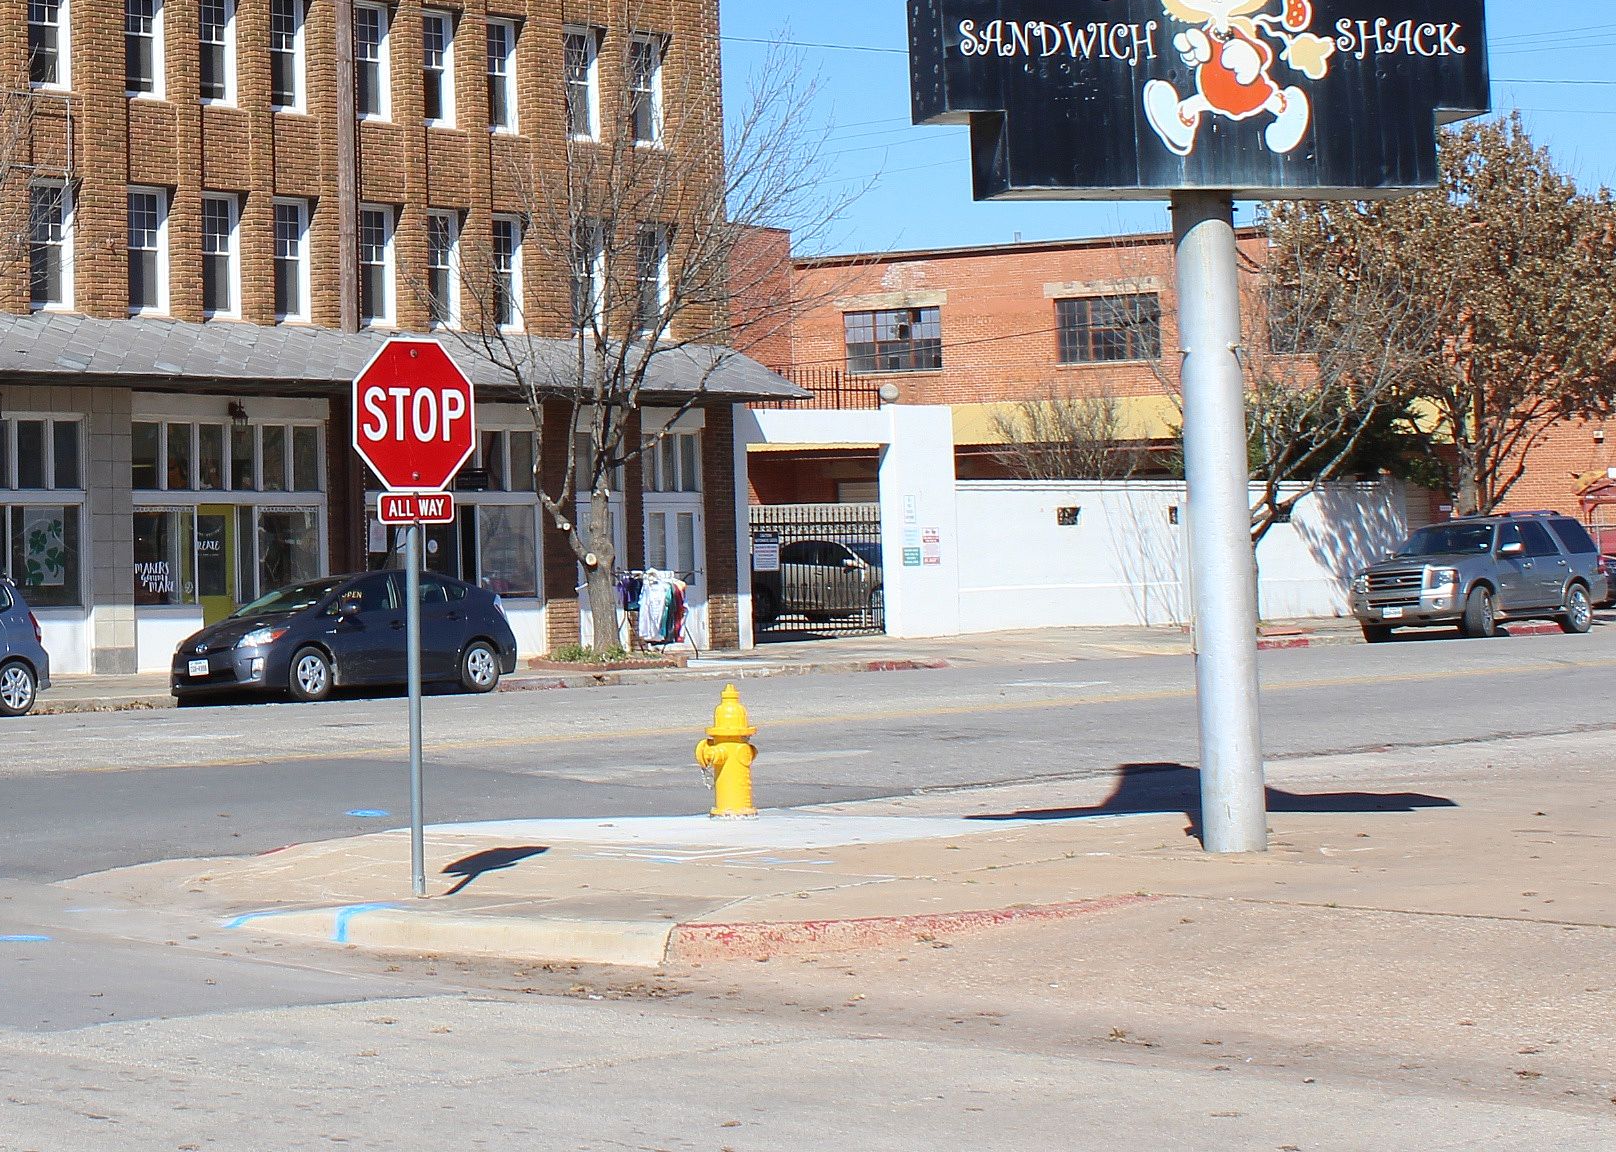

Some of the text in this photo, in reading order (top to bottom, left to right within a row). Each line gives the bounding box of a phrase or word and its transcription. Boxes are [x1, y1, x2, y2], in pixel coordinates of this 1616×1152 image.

[959, 17, 1466, 66] SANDWICH SHACK
[363, 386, 466, 442] STOP
[388, 499, 444, 517] ALL WAY
[134, 561, 170, 576] MAKERS
